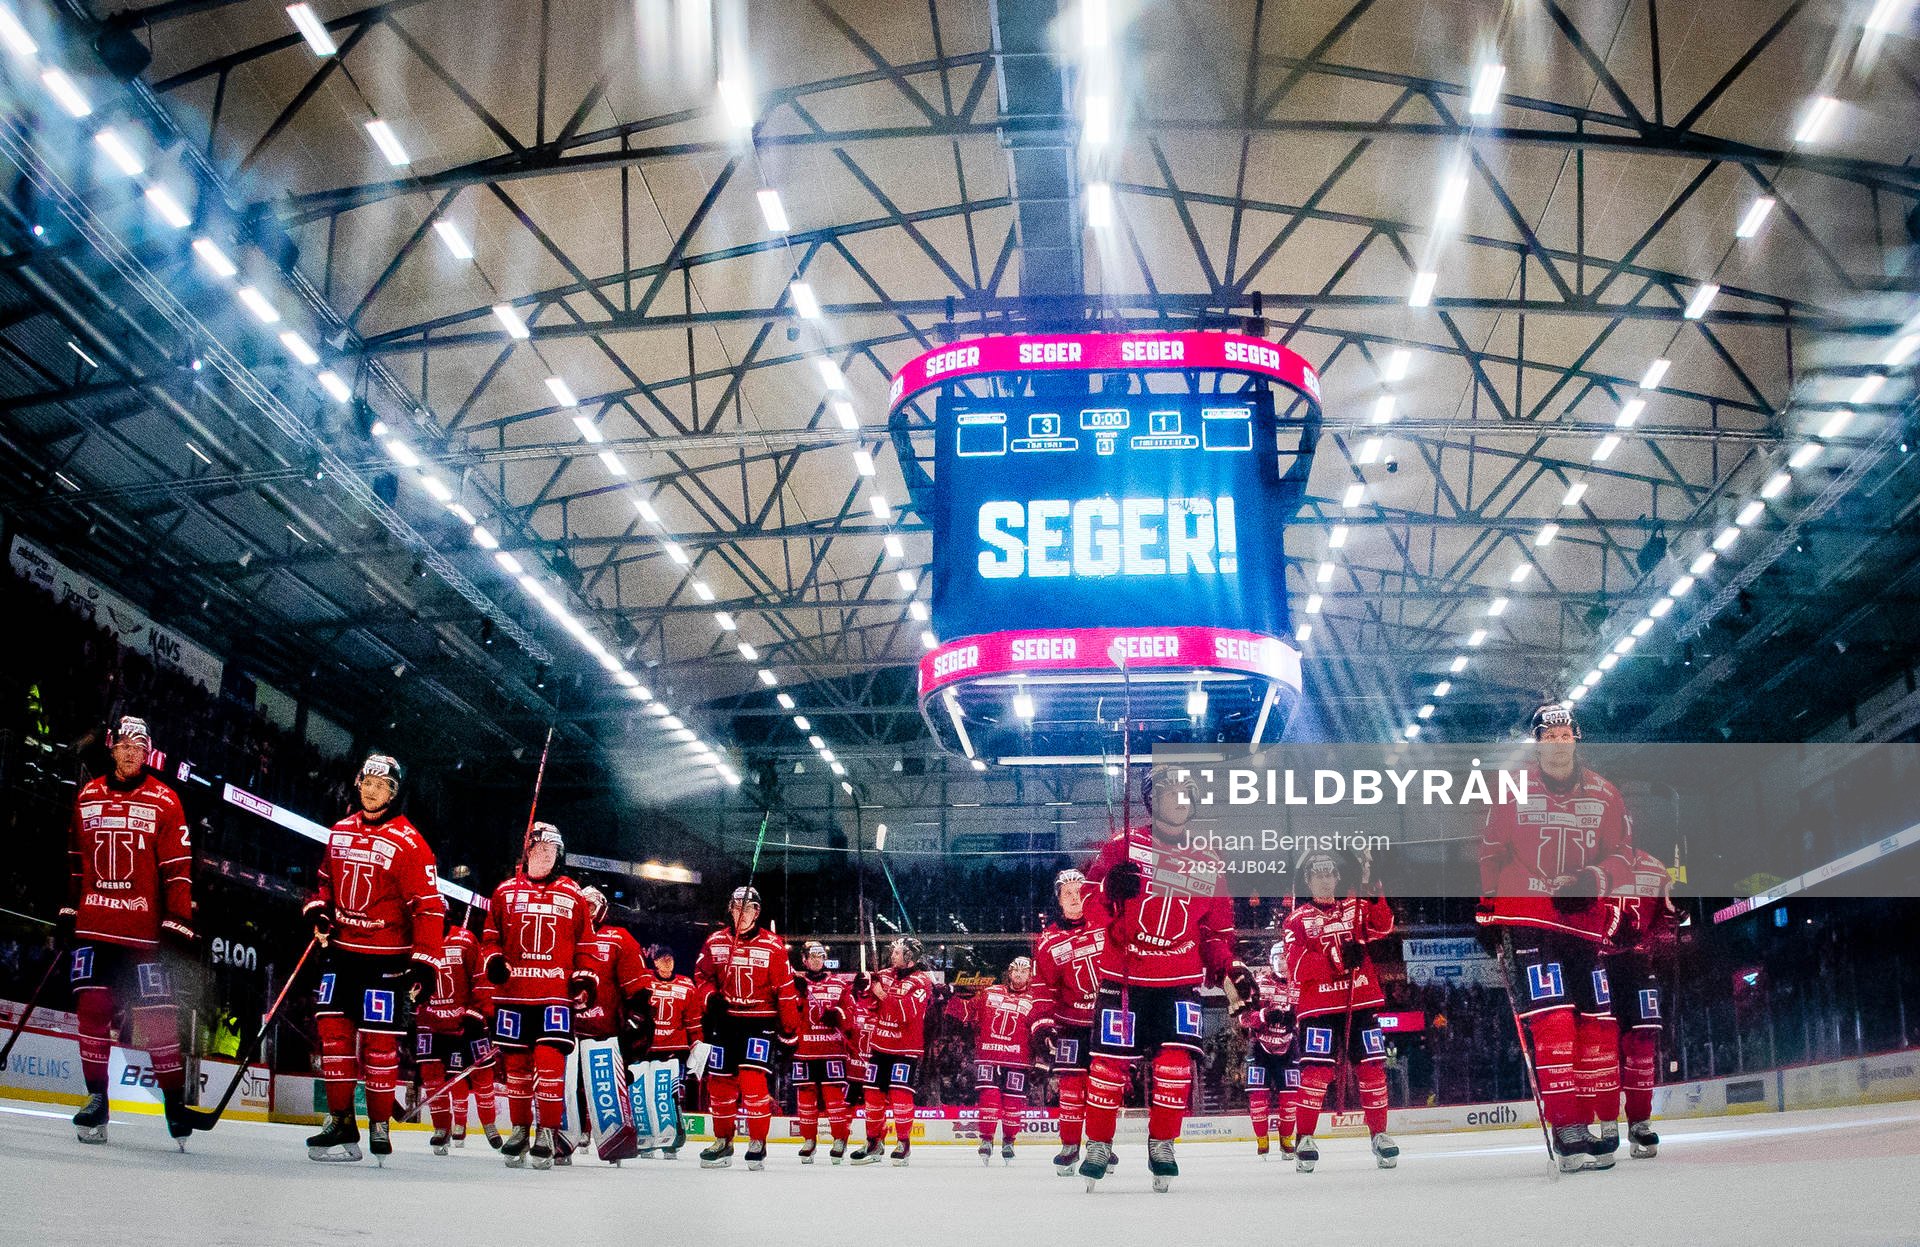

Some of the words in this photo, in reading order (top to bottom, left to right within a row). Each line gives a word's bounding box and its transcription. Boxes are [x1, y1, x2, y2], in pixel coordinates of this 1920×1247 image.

[926, 346, 980, 378] SEGER
[1019, 342, 1081, 363] SEGER
[1121, 340, 1185, 361] SEGER
[1224, 341, 1280, 370] SEGER
[1041, 418, 1053, 433] 3
[1091, 412, 1122, 426] 0:00
[1158, 416, 1167, 431] 1
[977, 496, 1238, 579] SEGER!
[934, 645, 979, 678] SEGER
[1011, 637, 1077, 661] SEGER
[1136, 931, 1172, 947] ÖREBR
[1089, 1093, 1114, 1104] STILL
[1154, 1093, 1184, 1104] STILL
